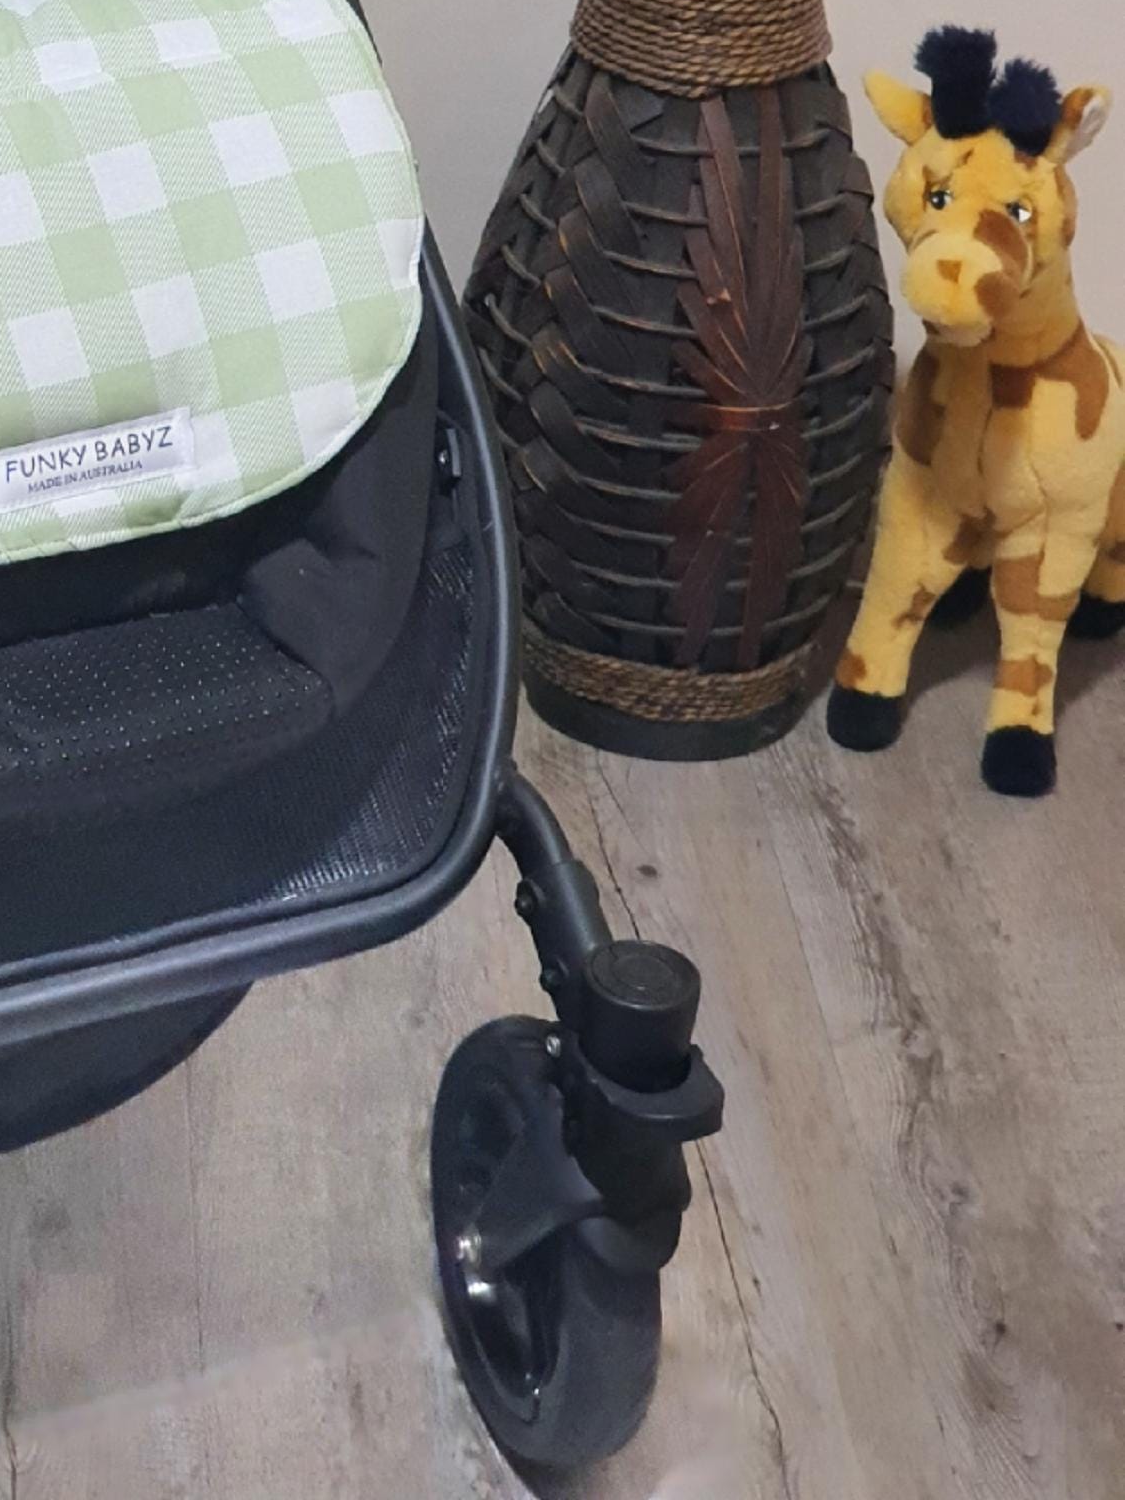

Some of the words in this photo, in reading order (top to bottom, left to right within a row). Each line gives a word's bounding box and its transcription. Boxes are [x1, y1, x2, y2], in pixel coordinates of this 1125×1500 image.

[5, 445, 87, 483] FUNKY
[94, 426, 173, 462] BABYZ
[28, 477, 63, 494] MADE
[64, 473, 78, 486] IN
[77, 460, 143, 482] AUSTRALIA
